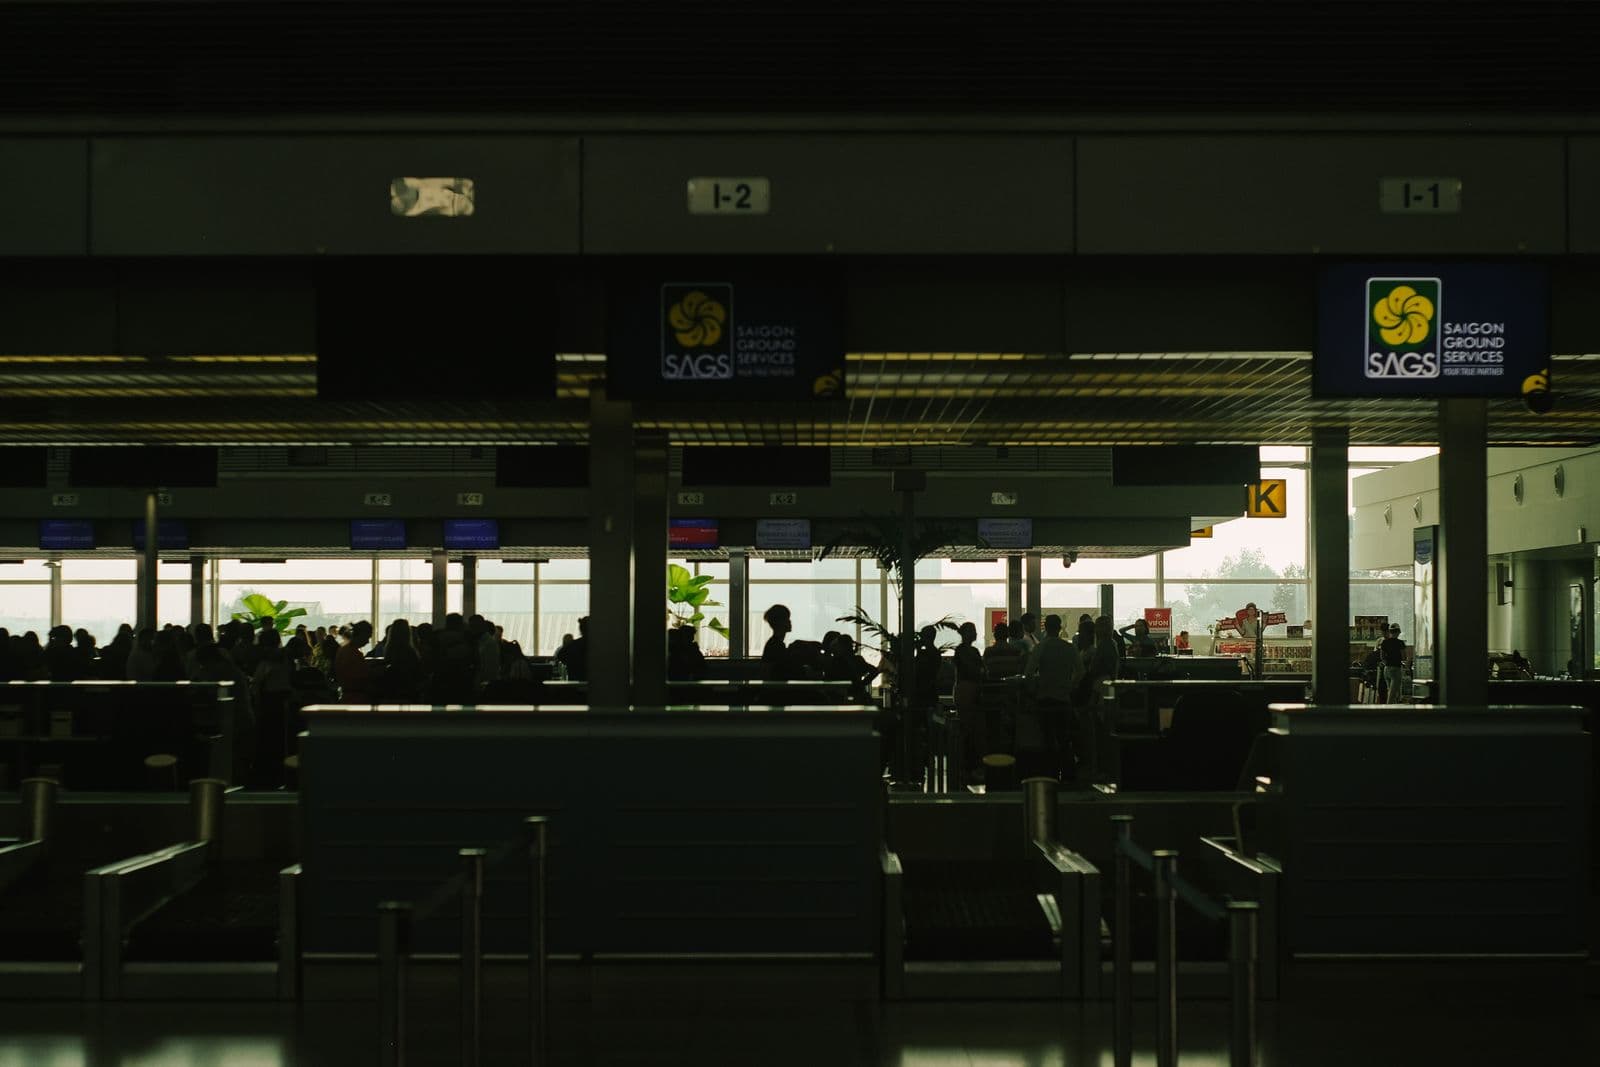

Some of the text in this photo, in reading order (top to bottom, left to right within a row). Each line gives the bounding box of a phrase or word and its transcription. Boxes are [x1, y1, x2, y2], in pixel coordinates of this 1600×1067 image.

[714, 184, 751, 208] I-2
[1404, 184, 1439, 208] I-1
[736, 325, 796, 337] SAIGON
[1443, 322, 1505, 334] SAIGON
[736, 339, 797, 351] GROUND
[1442, 336, 1506, 349] GROUND
[736, 352, 796, 364] SERVICES
[1443, 351, 1505, 363] SERVICES
[664, 353, 731, 379] SAGS
[1368, 351, 1438, 377] SAGS
[1255, 483, 1280, 513] K
[1147, 619, 1170, 628] VIFON
